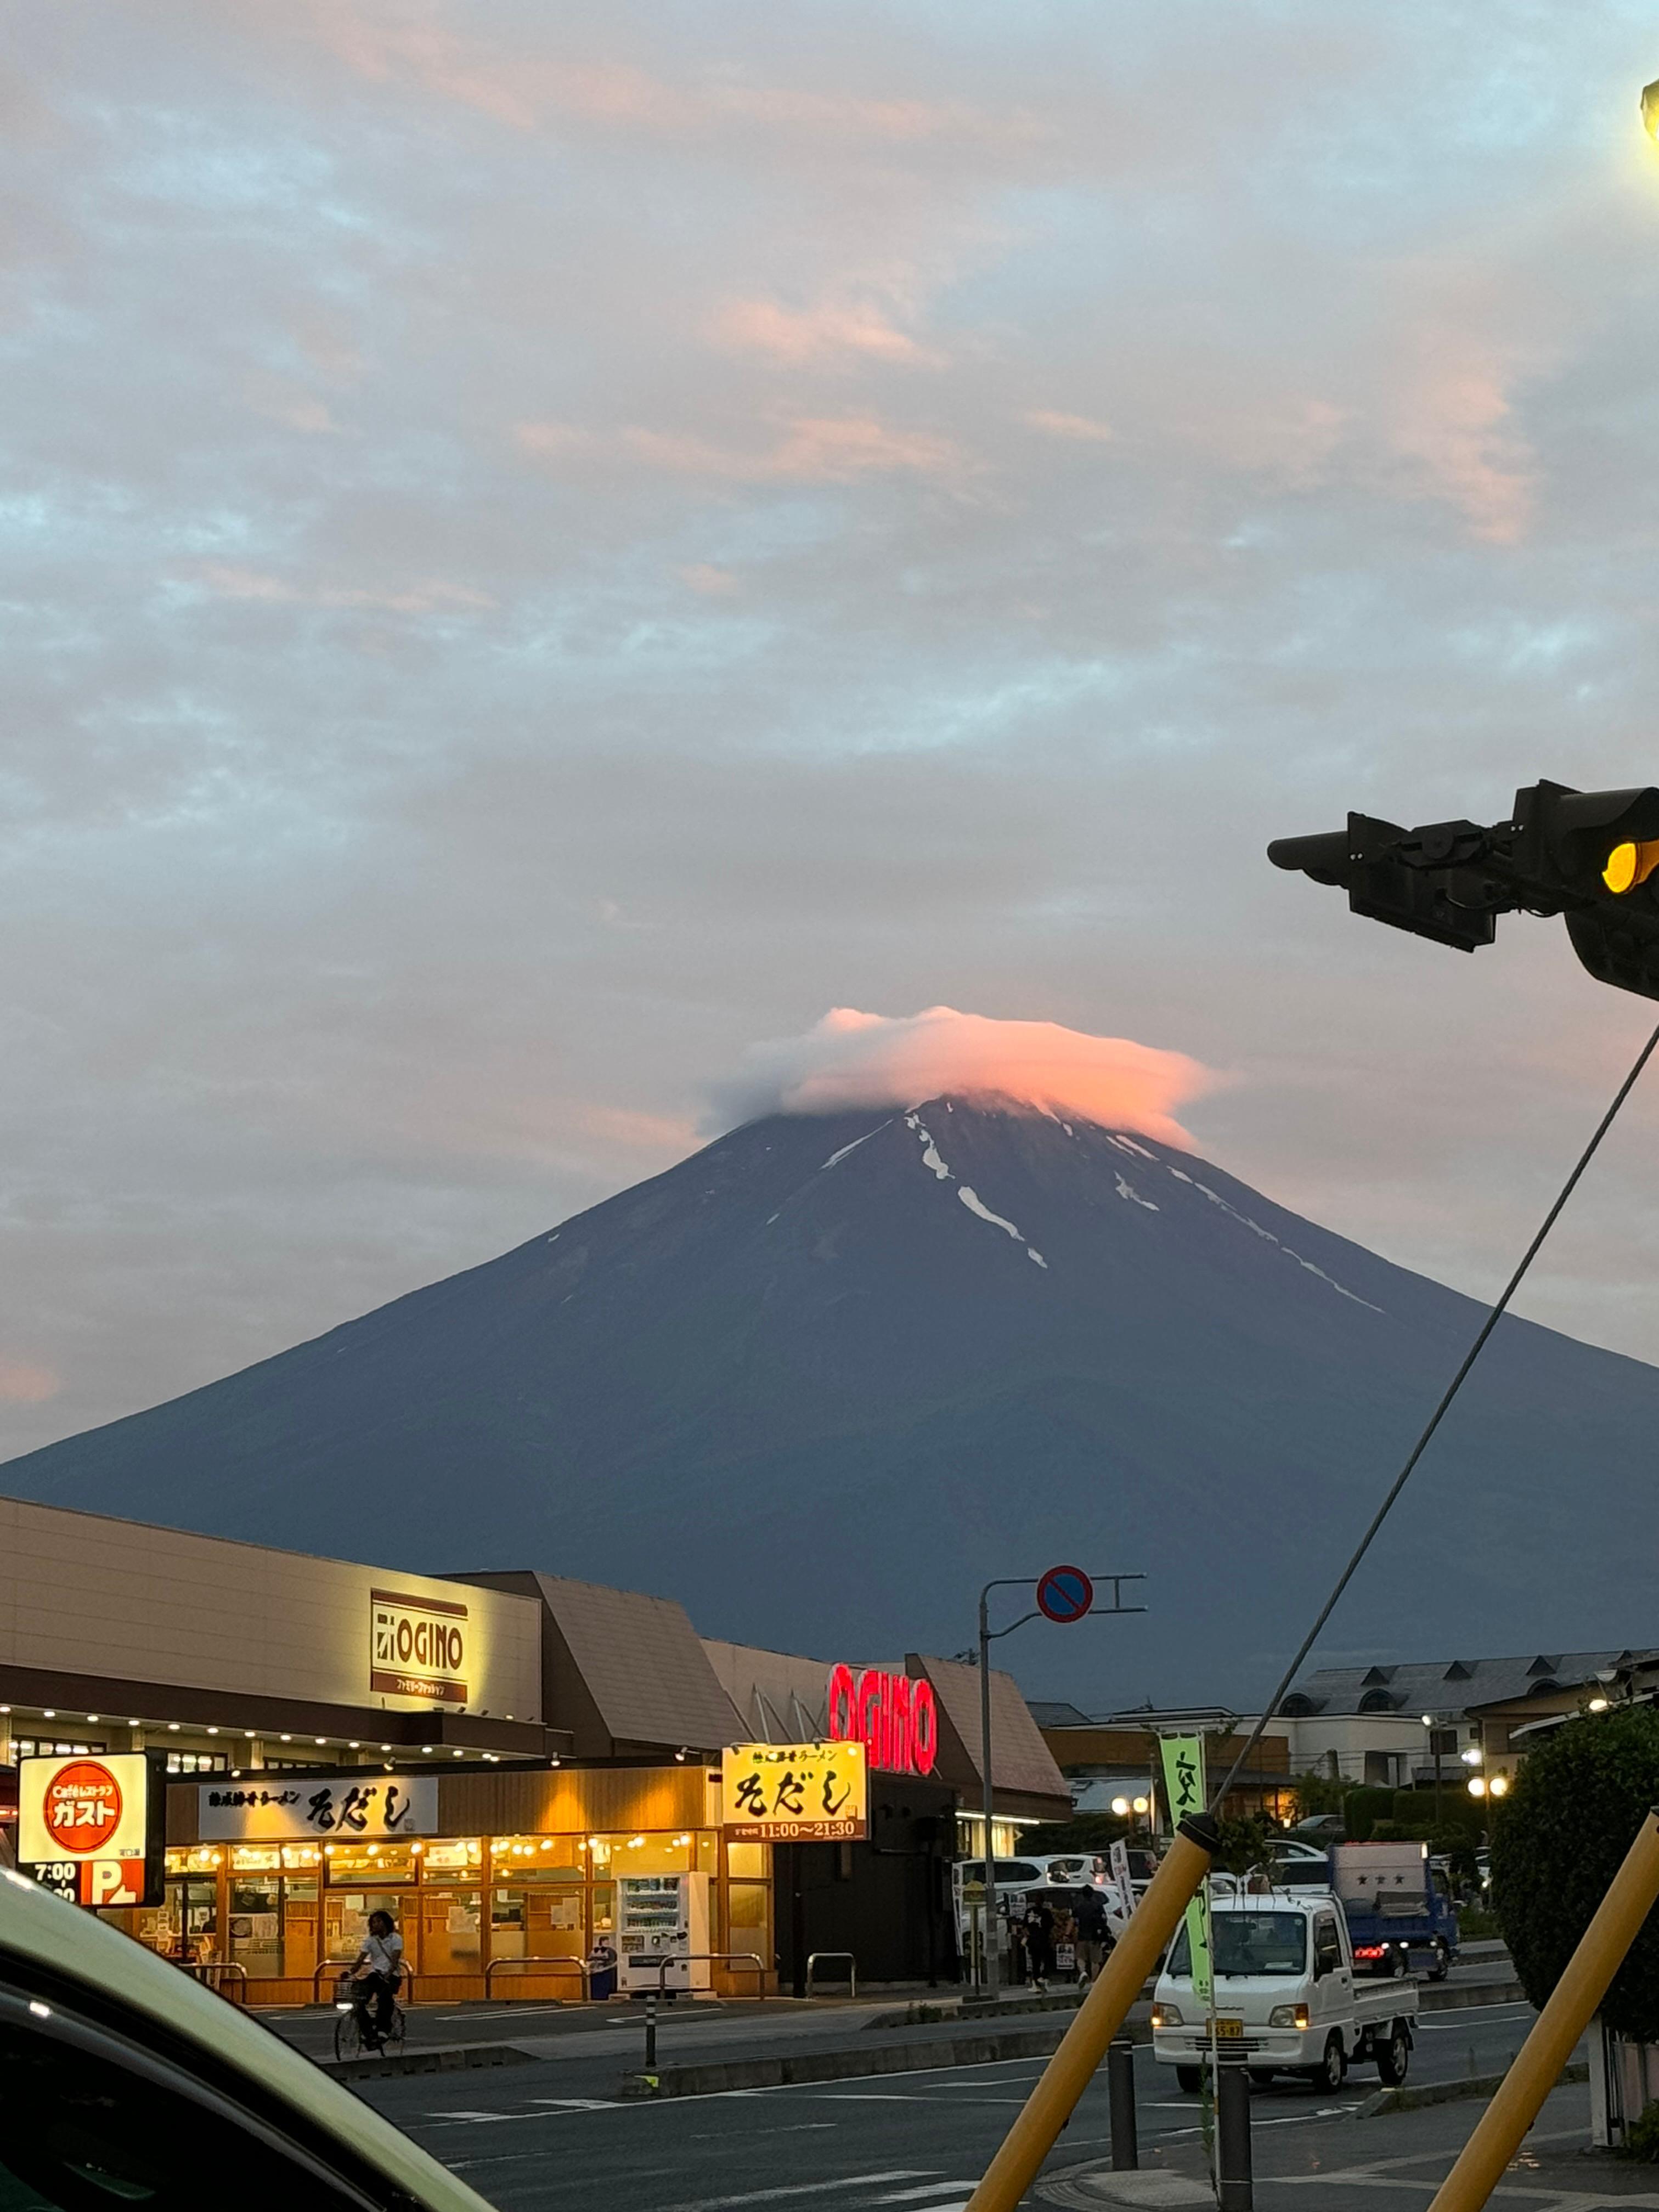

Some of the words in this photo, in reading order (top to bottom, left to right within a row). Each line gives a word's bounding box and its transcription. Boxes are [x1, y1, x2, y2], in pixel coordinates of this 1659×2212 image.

[397, 1619, 462, 1670] OGINO
[830, 1662, 937, 1776] OGINO
[53, 1801, 115, 1827] ガスト
[35, 1863, 76, 1881] 7:00
